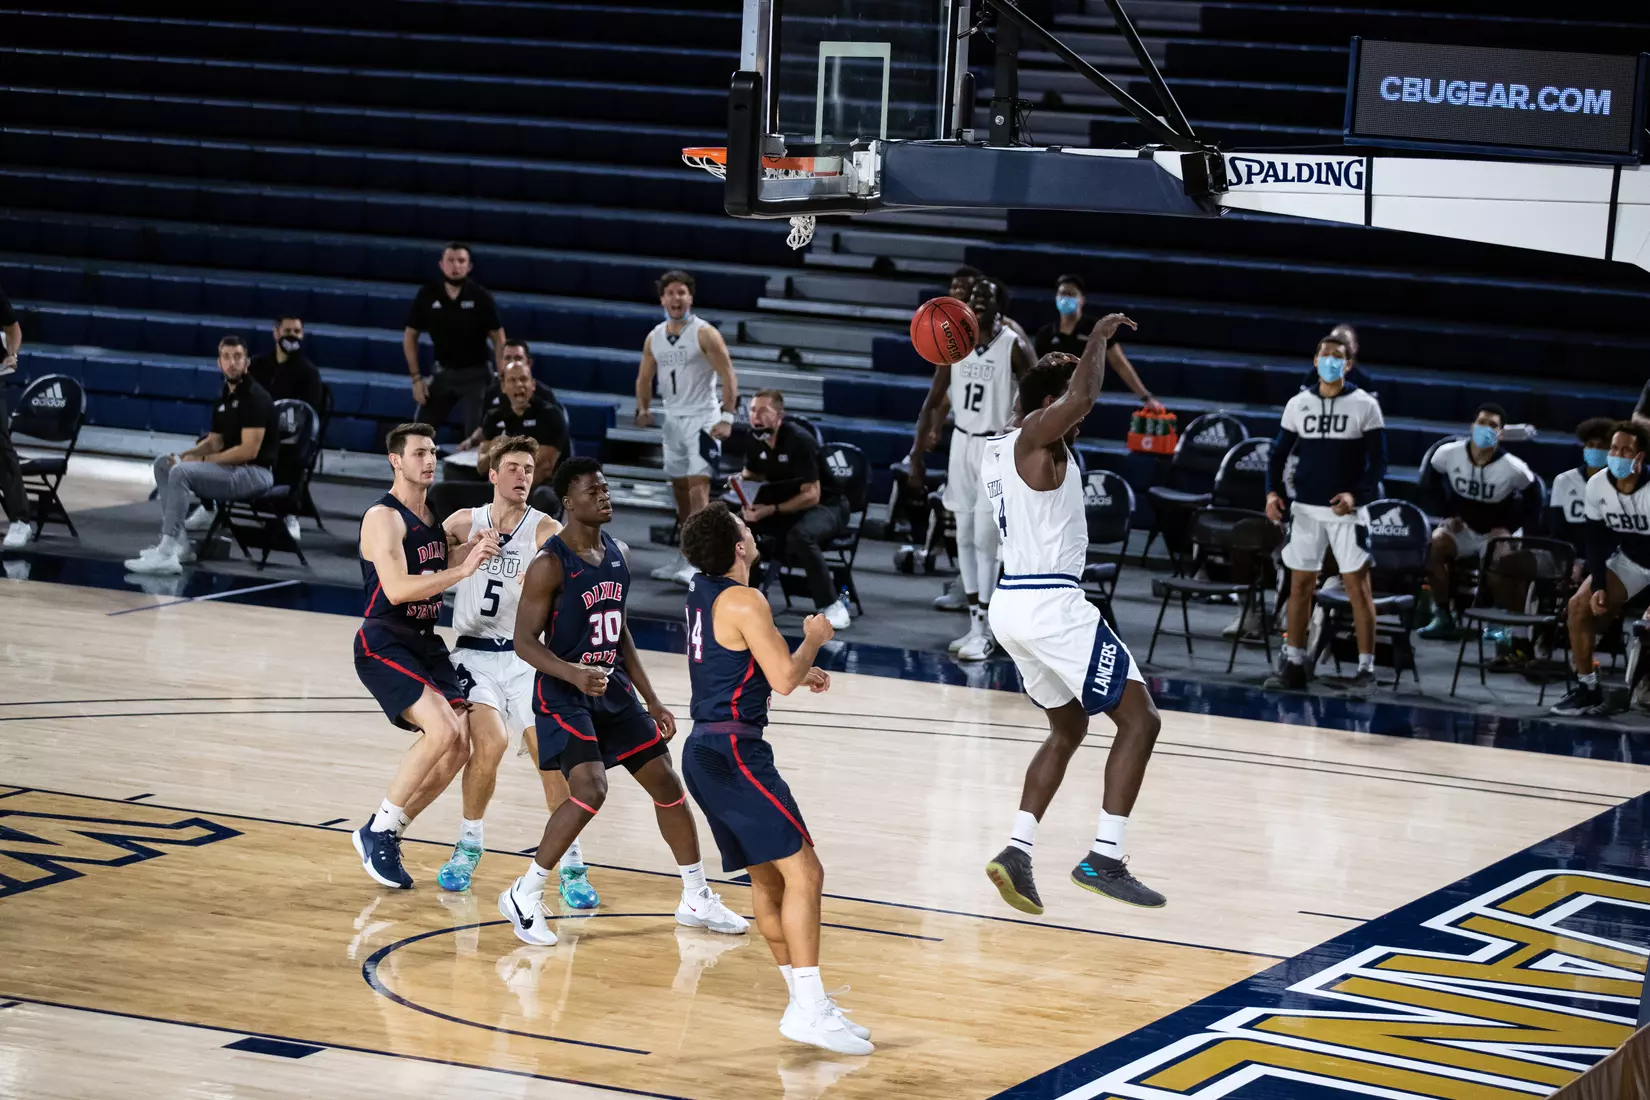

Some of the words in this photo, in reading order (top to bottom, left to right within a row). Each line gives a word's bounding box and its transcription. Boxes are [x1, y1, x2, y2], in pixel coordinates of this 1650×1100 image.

[1379, 76, 1612, 115] CBUGEAR.COM
[1228, 156, 1364, 190] SPALDING
[940, 320, 962, 360] Wilson
[960, 362, 995, 381] CBU
[31, 396, 68, 408] adidas
[964, 383, 985, 412] 12
[1303, 414, 1349, 433] CBU
[1235, 460, 1268, 471] adida
[1454, 477, 1496, 499] CBU
[1606, 512, 1649, 530] CBU
[480, 578, 504, 618] 5
[581, 581, 623, 610] DIXIE
[589, 609, 622, 648] 30
[1091, 641, 1118, 697] LANCERS
